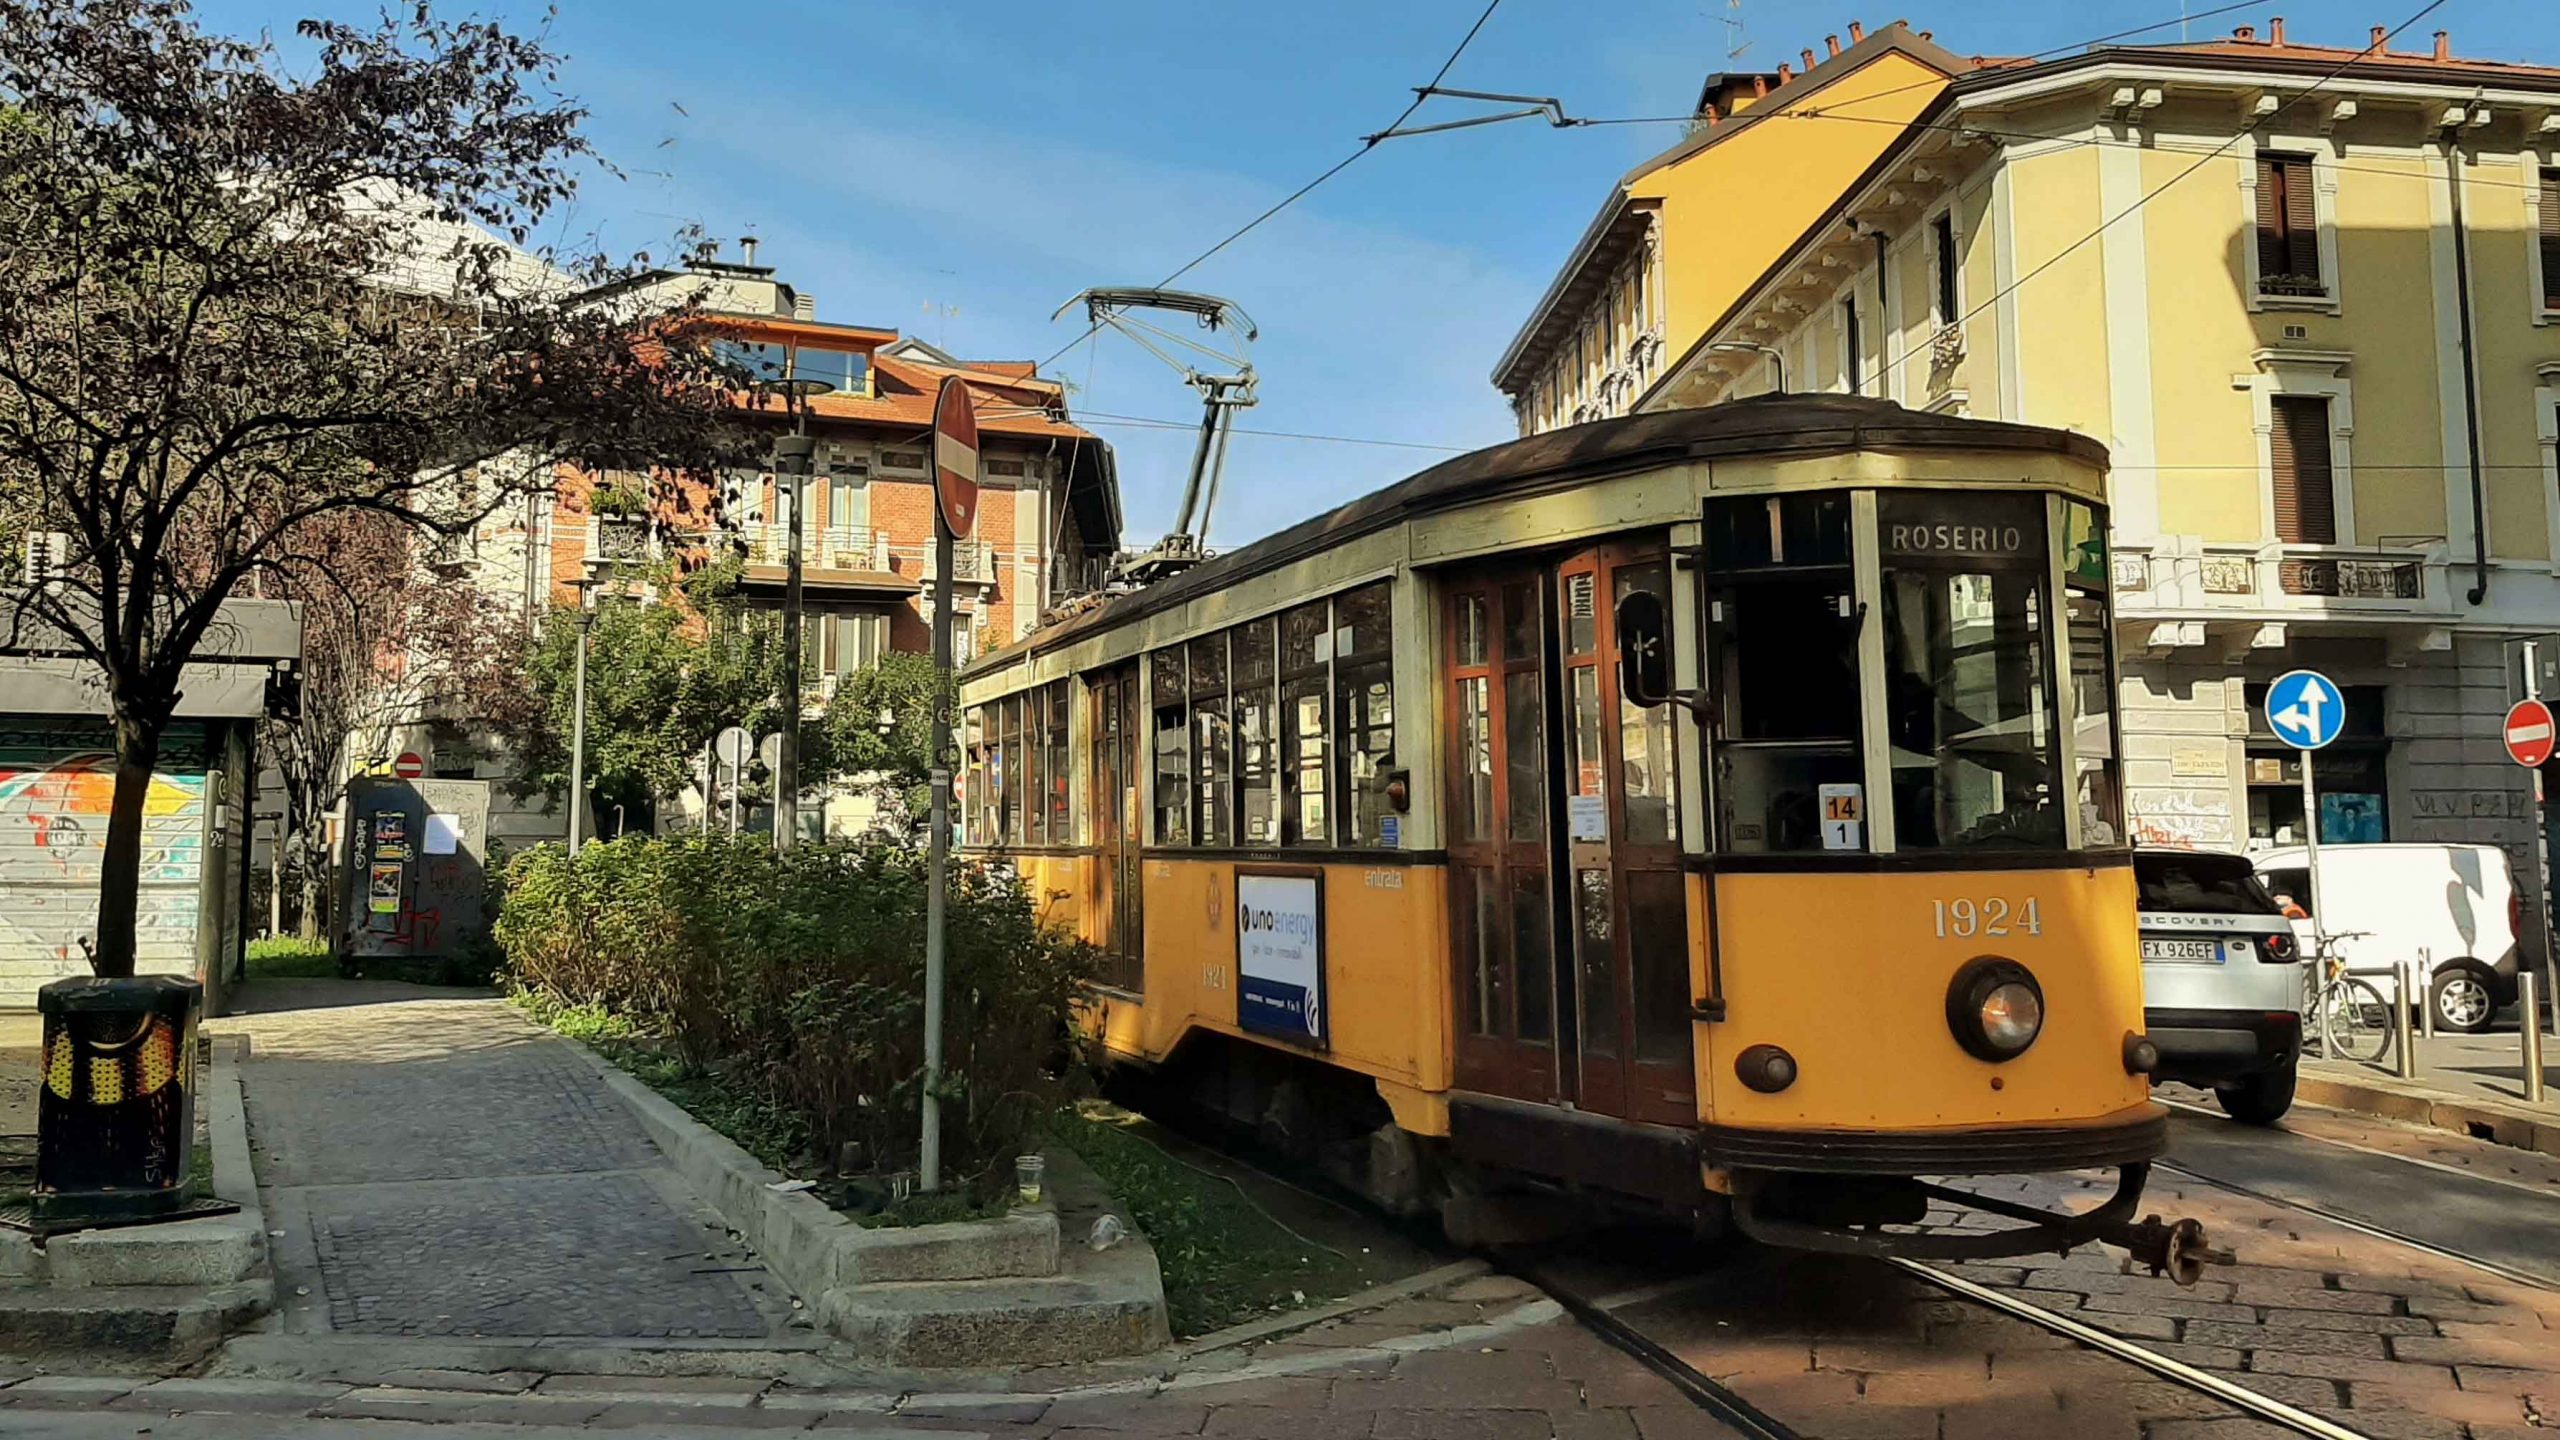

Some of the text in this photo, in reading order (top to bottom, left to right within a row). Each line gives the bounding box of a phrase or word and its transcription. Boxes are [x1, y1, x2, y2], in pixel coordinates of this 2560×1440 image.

[1892, 525, 2021, 551] ROSERIO
[1828, 797, 1856, 819] 14
[1837, 823, 1846, 844] 1
[1251, 909, 1315, 946] unoenergy
[1931, 896, 2041, 937] 1924
[1202, 962, 1227, 990] 1924
